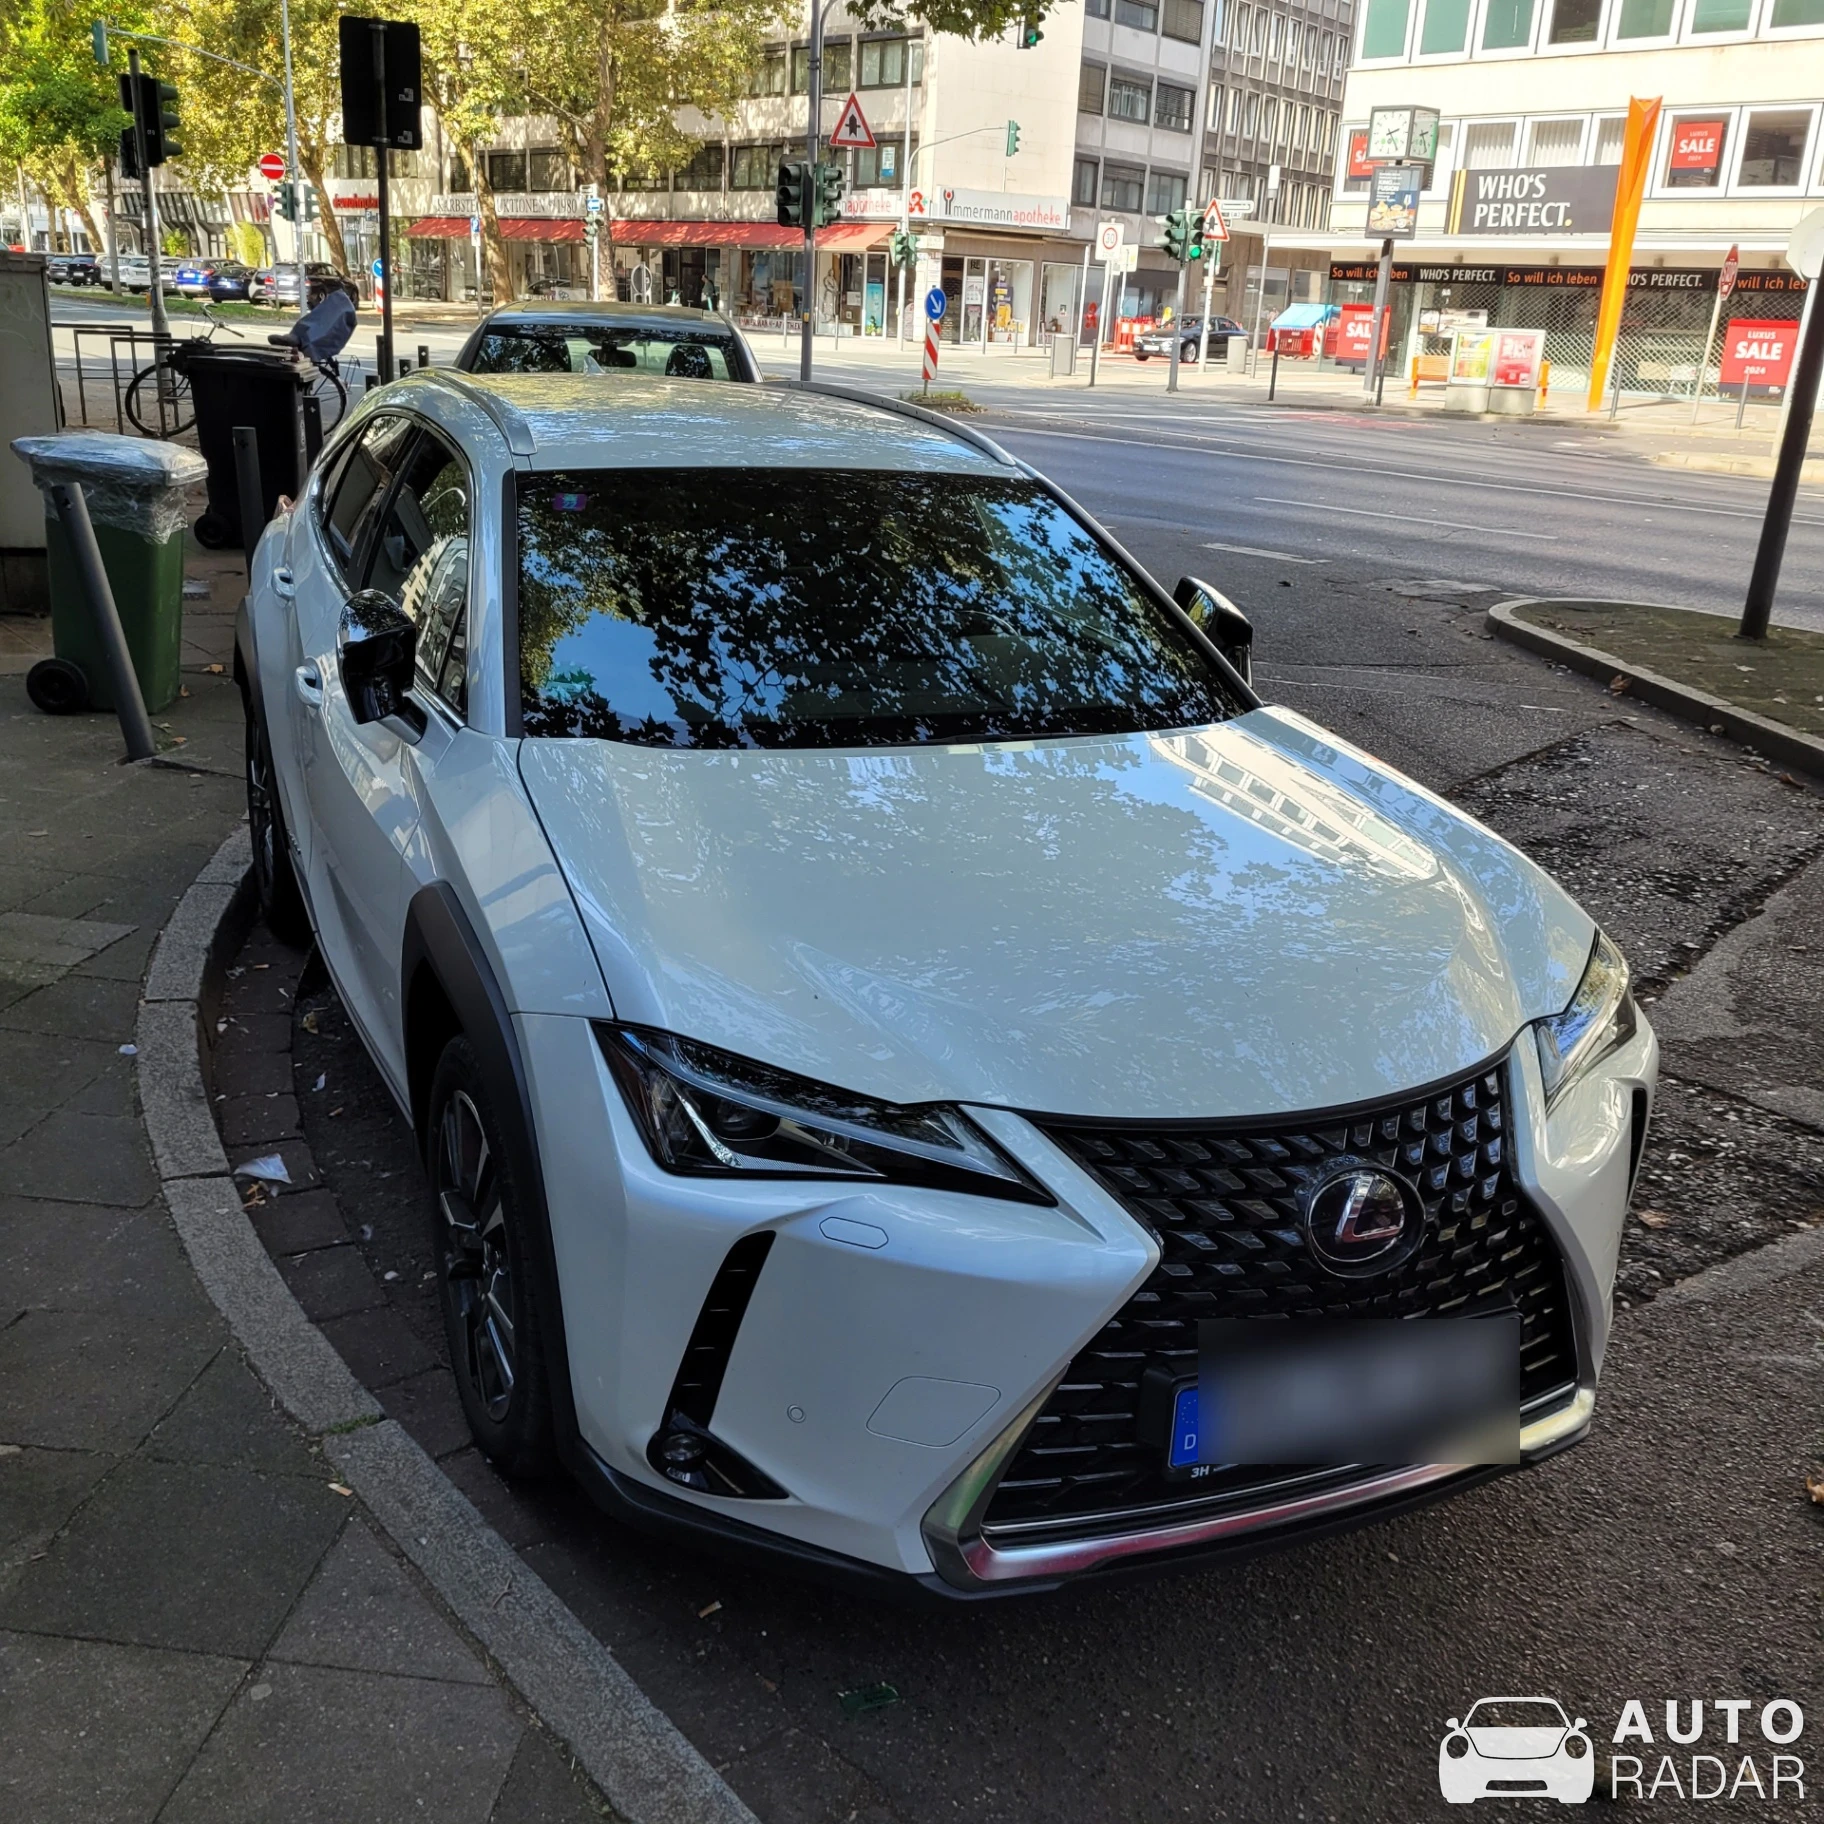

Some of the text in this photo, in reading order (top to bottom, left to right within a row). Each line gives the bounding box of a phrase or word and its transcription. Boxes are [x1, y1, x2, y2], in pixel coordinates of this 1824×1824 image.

[1678, 138, 1715, 153] SALE
[1478, 173, 1547, 199] WHO'S
[496, 198, 547, 213] UKTIONEN
[1473, 202, 1573, 227] PERFECT.
[1105, 233, 1115, 244] 30
[1332, 267, 1343, 278] So
[1345, 267, 1363, 278] will
[1391, 268, 1408, 279] ben
[1420, 268, 1496, 282] WHO'S PERFECT.
[1507, 271, 1597, 285] So will ich leben
[1650, 273, 1703, 287] PERFECT.
[1737, 277, 1761, 289] will
[1765, 277, 1784, 290] ich
[1346, 322, 1372, 338] SAL
[1747, 331, 1776, 340] LUXUS
[1735, 341, 1784, 360] SALE
[1744, 366, 1766, 375] 2024
[1184, 1433, 1197, 1450] D
